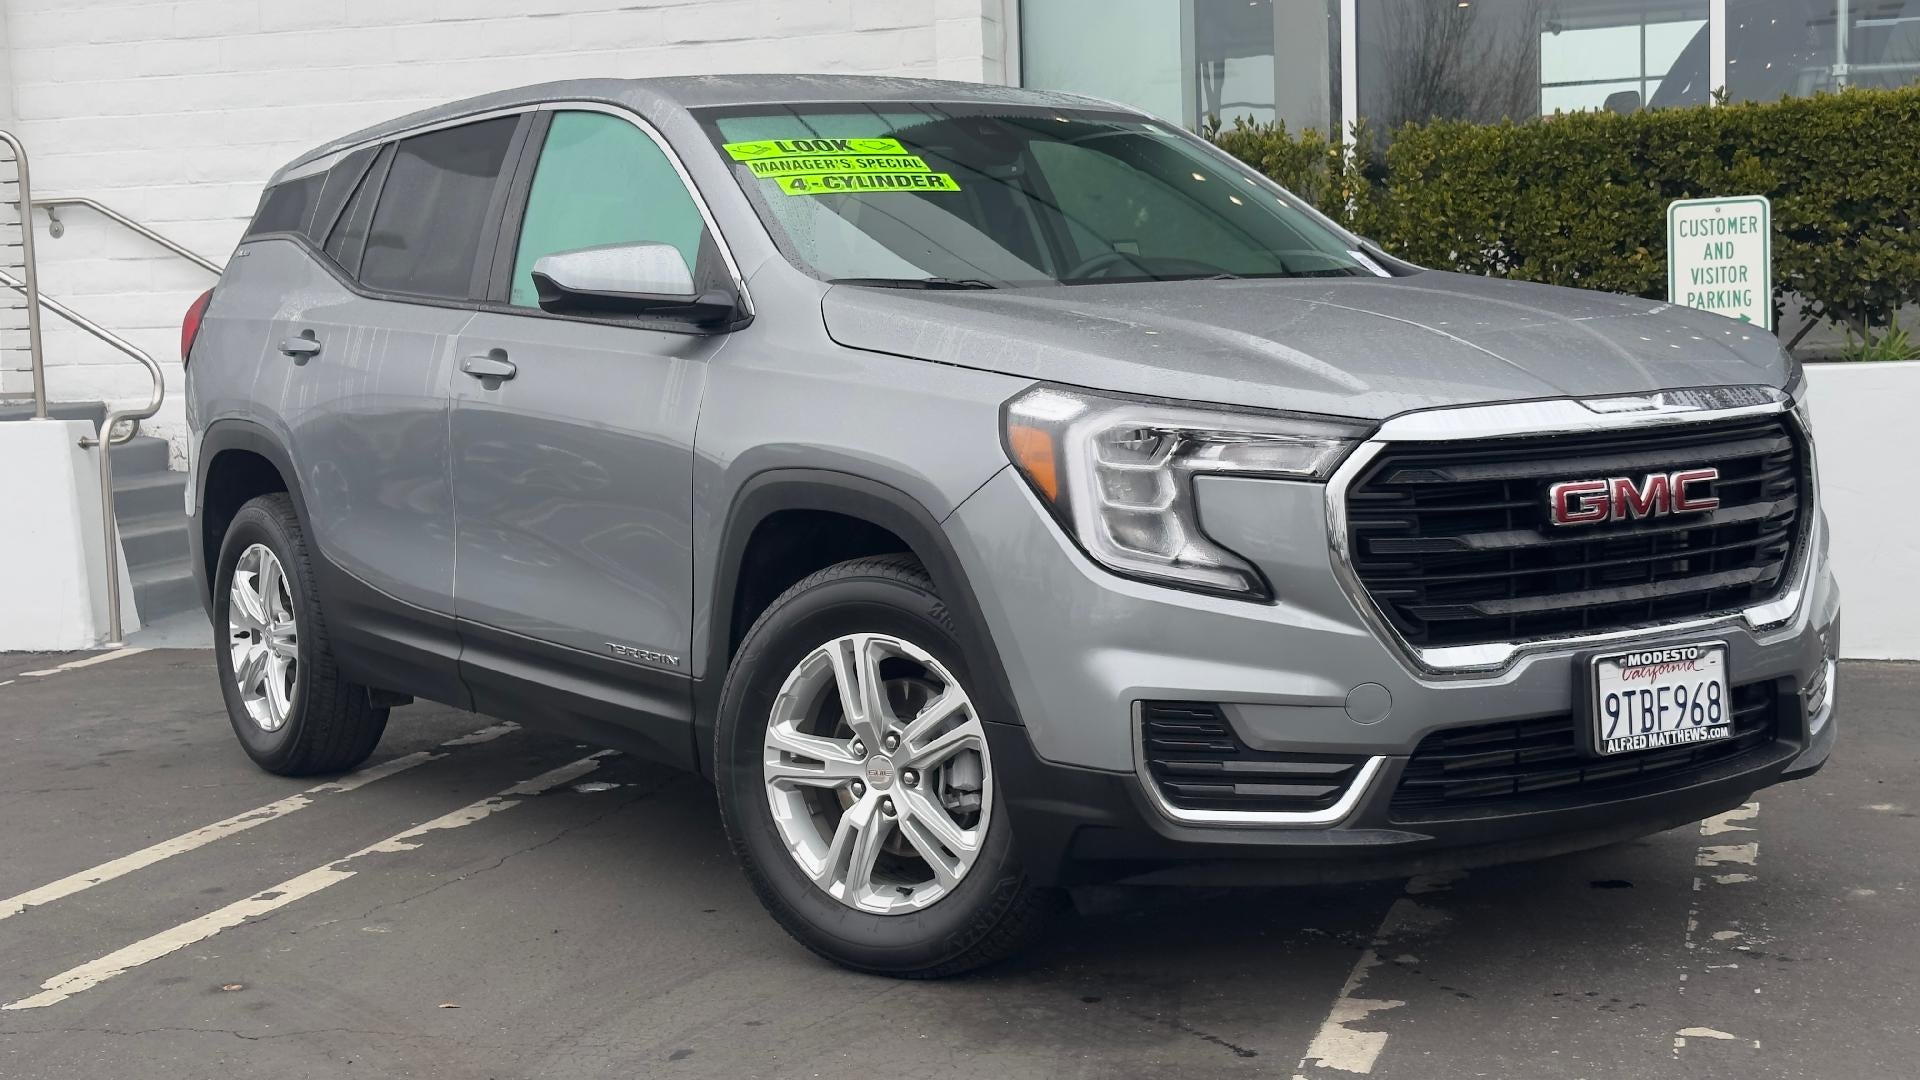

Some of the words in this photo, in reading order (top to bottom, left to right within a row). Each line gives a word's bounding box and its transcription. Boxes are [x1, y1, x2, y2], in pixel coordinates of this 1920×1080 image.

[774, 139, 857, 154] LOOK
[753, 158, 851, 173] MANAGER'S
[858, 156, 923, 169] SPECIAL
[789, 175, 945, 191] 4-CYLINDER
[1679, 216, 1758, 238] CUSTOMER
[1703, 241, 1734, 260] AND
[1690, 265, 1748, 285] VISITOR
[1687, 289, 1752, 310] PARKING
[1549, 467, 1720, 526] GMC
[604, 642, 680, 667] TERRAIN
[1627, 647, 1698, 667] MODESTO
[1622, 660, 1704, 685] California
[1604, 680, 1722, 739] 9TBF968
[1607, 735, 1647, 753] ALFRED
[1648, 726, 1729, 749] MATTHEWS.COM
